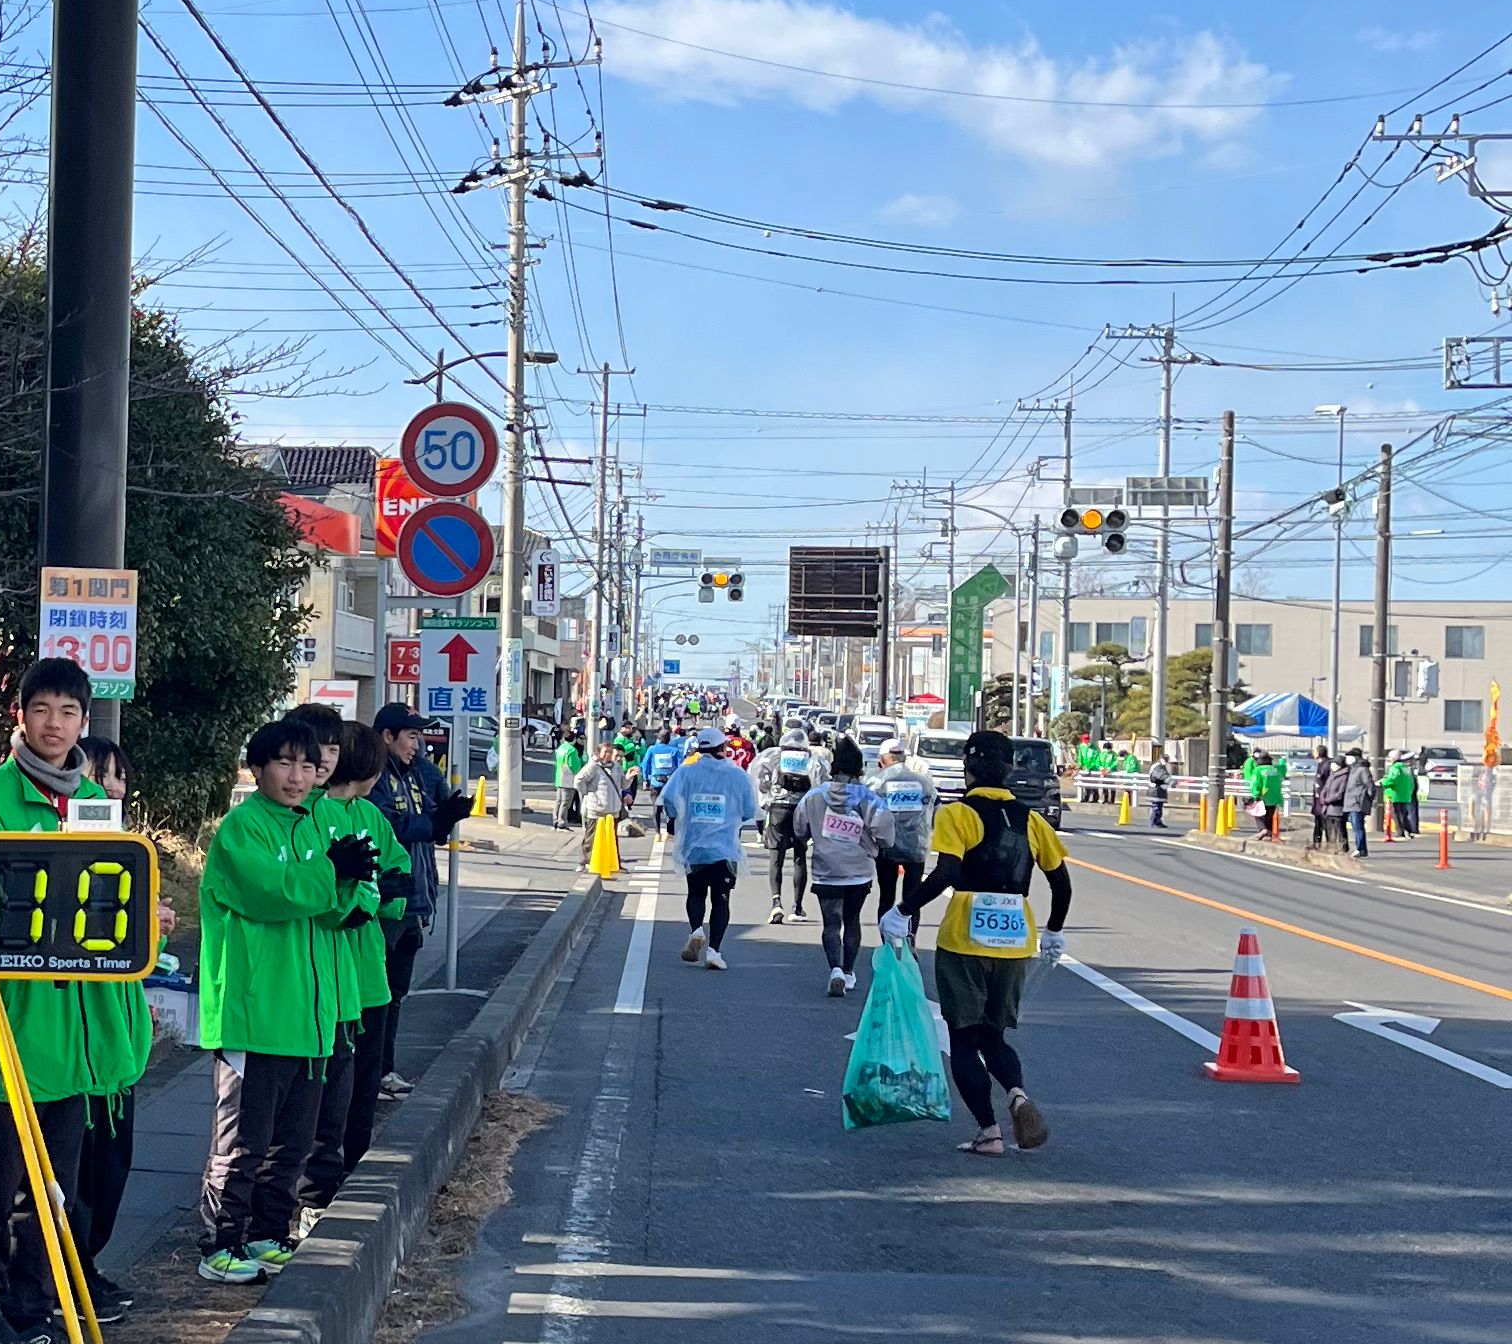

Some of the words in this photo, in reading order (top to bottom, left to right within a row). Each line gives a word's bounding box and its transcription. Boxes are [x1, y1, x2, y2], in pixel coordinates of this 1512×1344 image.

[424, 430, 476, 471] 50
[48, 576, 130, 598] 第1関門
[49, 609, 127, 629] 閉鎖時刻
[428, 687, 487, 712] 直進
[48, 956, 91, 969] Sports
[94, 956, 132, 969] Timer
